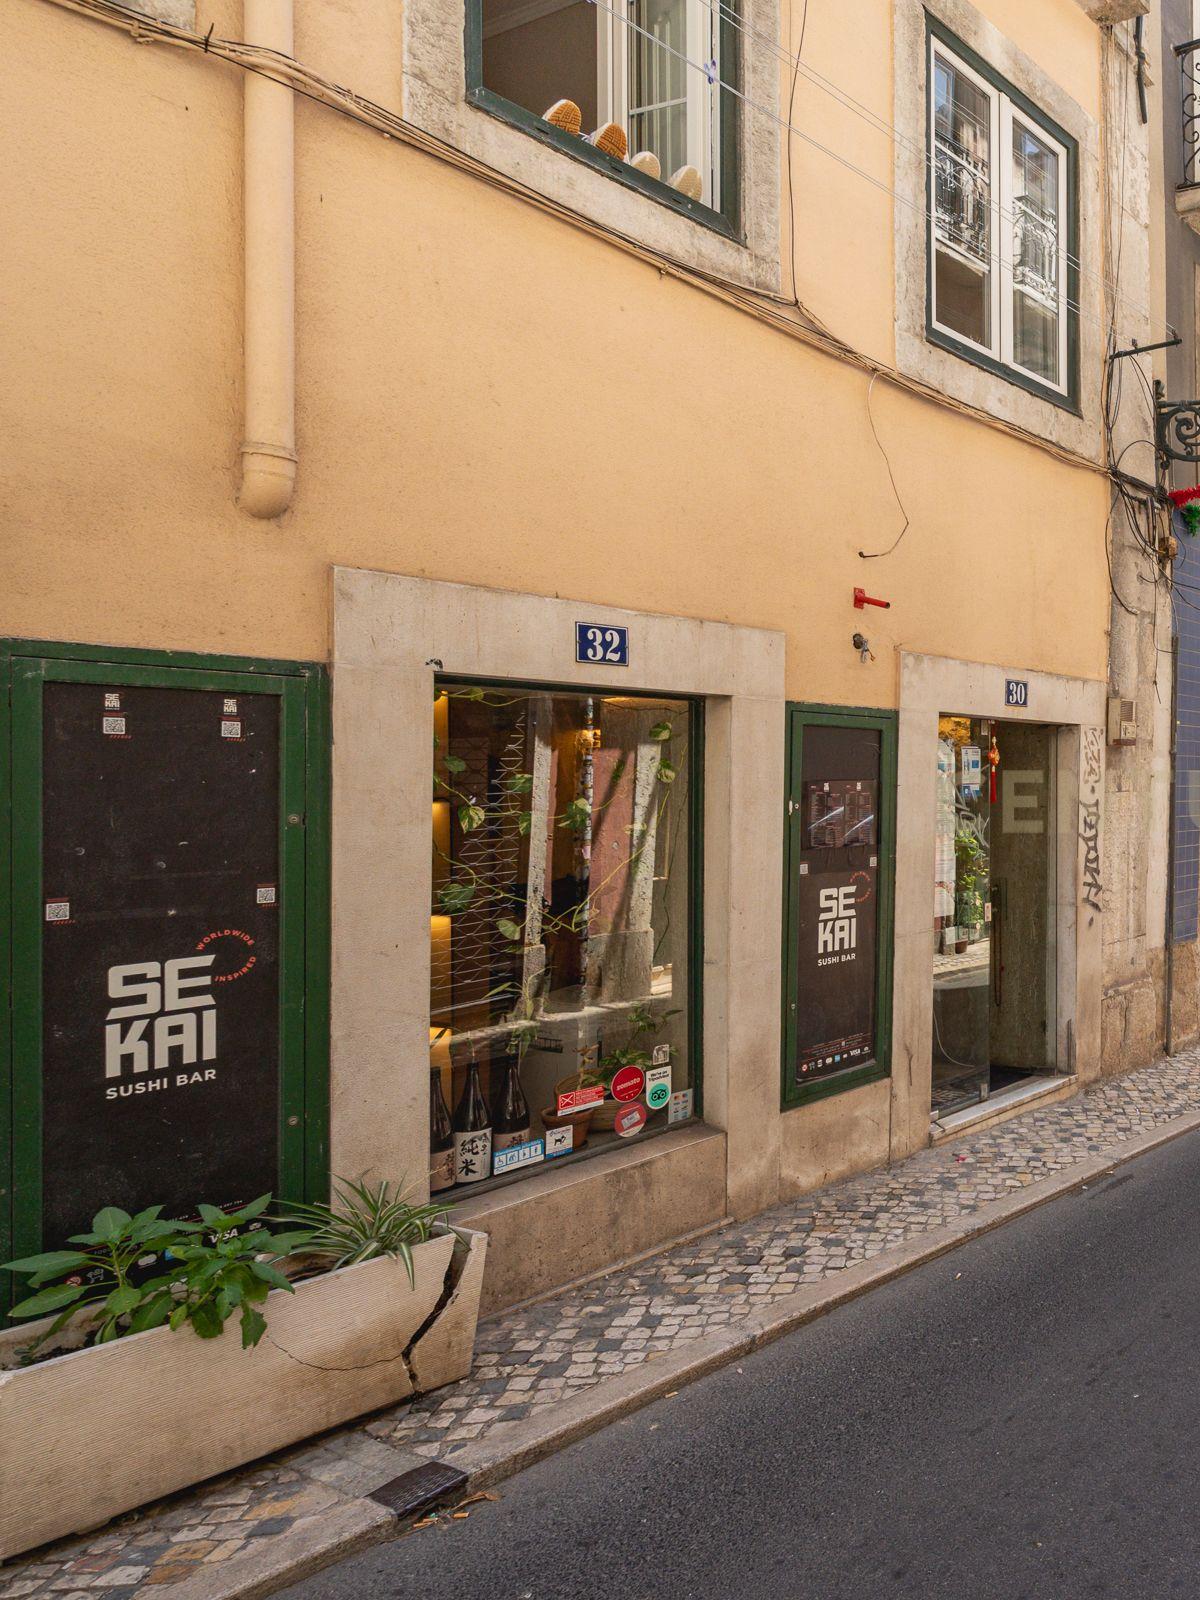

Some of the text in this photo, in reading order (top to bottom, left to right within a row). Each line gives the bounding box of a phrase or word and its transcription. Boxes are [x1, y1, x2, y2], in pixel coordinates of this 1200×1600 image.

[587, 628, 620, 661] 32
[1009, 682, 1025, 704] 30
[819, 885, 857, 920] SE
[196, 929, 255, 951] WORLDWIDE
[818, 917, 857, 954] KAI
[211, 956, 257, 982] INSPIRED
[818, 953, 857, 967] SUSHI BAR
[106, 954, 216, 1020] SE
[106, 1009, 216, 1079] KAI
[106, 1069, 216, 1100] SUSHI BAR
[616, 1077, 641, 1091] zomato
